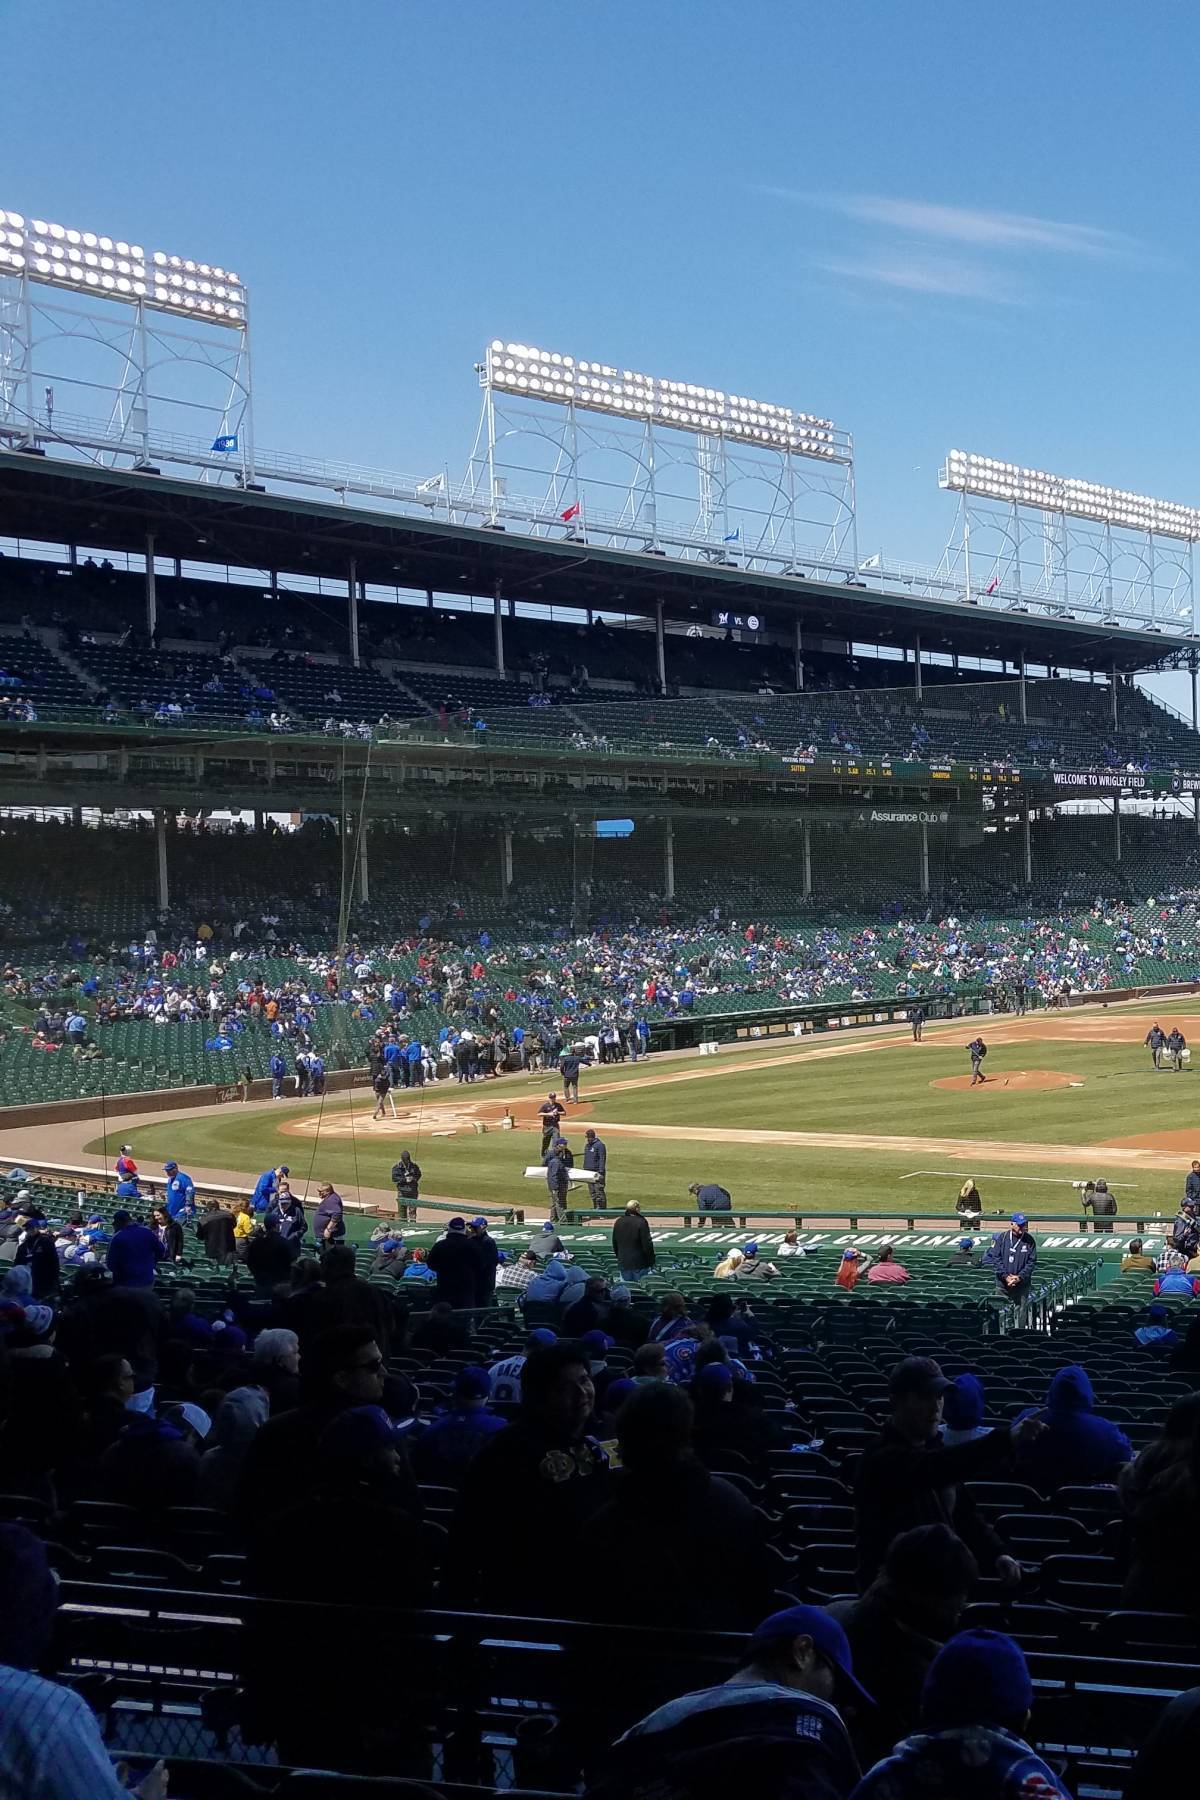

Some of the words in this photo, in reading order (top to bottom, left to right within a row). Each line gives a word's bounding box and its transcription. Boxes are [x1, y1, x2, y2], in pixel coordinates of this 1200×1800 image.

[1053, 773, 1087, 785] WELCOME
[1088, 775, 1097, 785] TO
[1099, 775, 1126, 787] WRIGLEY
[1128, 777, 1145, 787] FIELD
[870, 810, 918, 821] Assurance
[919, 811, 938, 822] Club
[832, 1234, 988, 1246] CONFINES
